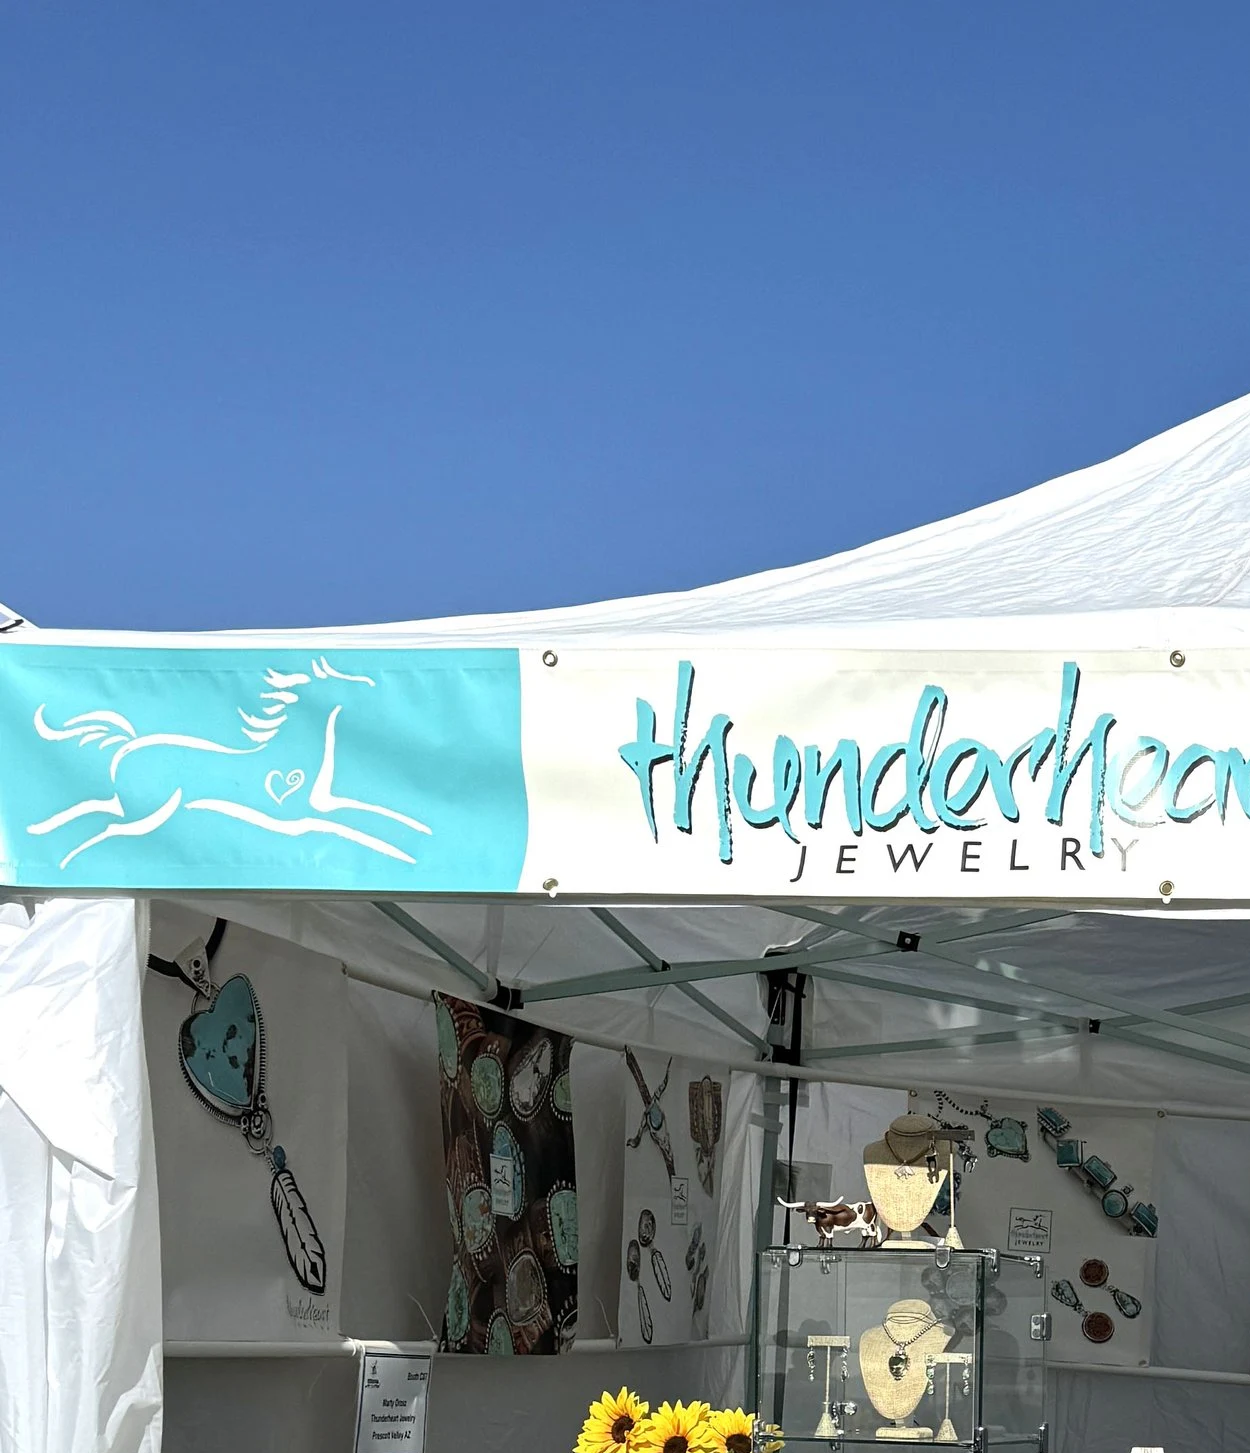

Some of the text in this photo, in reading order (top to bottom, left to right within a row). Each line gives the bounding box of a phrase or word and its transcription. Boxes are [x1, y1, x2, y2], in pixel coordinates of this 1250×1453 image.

[789, 837, 1139, 882] JEWELRY
[371, 1414, 416, 1424] Thunderheart Jewelry
[372, 1431, 390, 1440] Prescott
[404, 1430, 411, 1439] AZ
